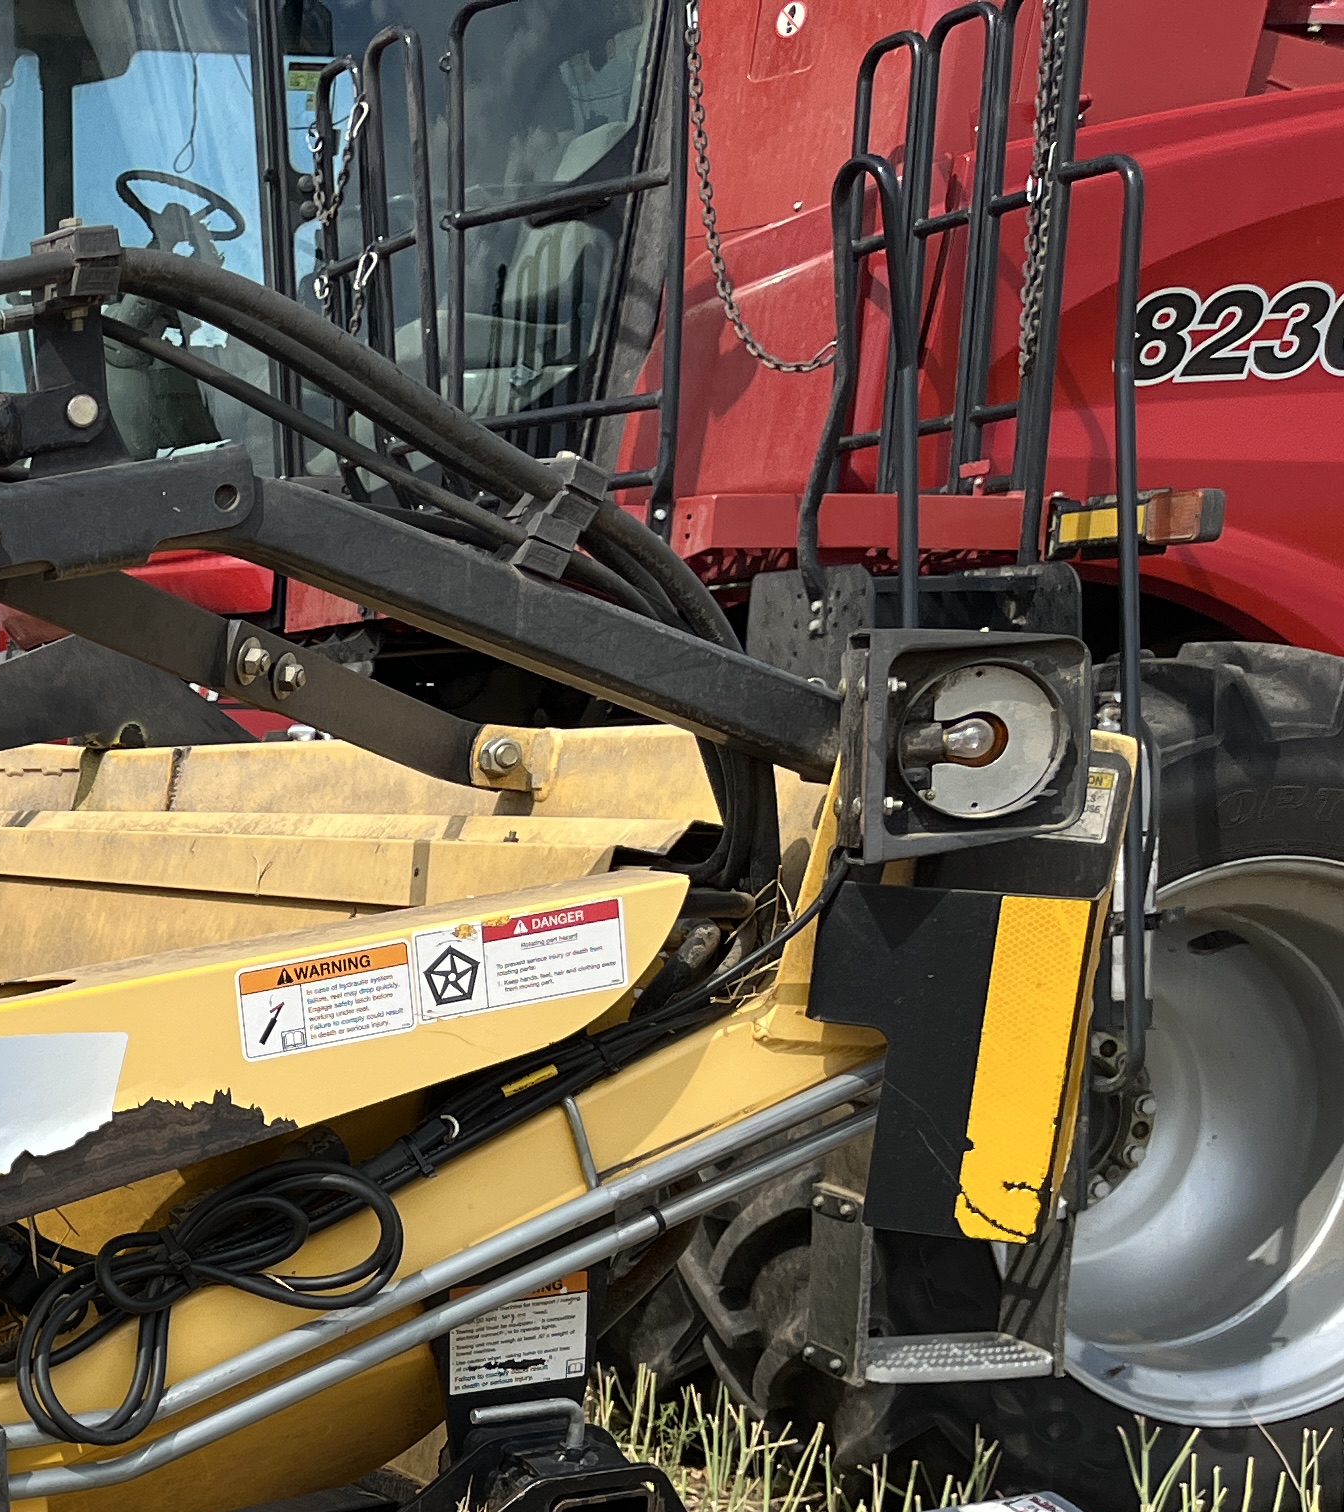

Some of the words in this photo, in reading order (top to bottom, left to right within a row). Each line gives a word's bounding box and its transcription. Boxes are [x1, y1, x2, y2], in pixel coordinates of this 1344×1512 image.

[1134, 280, 1344, 386] 823
[531, 910, 584, 930] DANGER
[294, 954, 371, 980] WARNING
